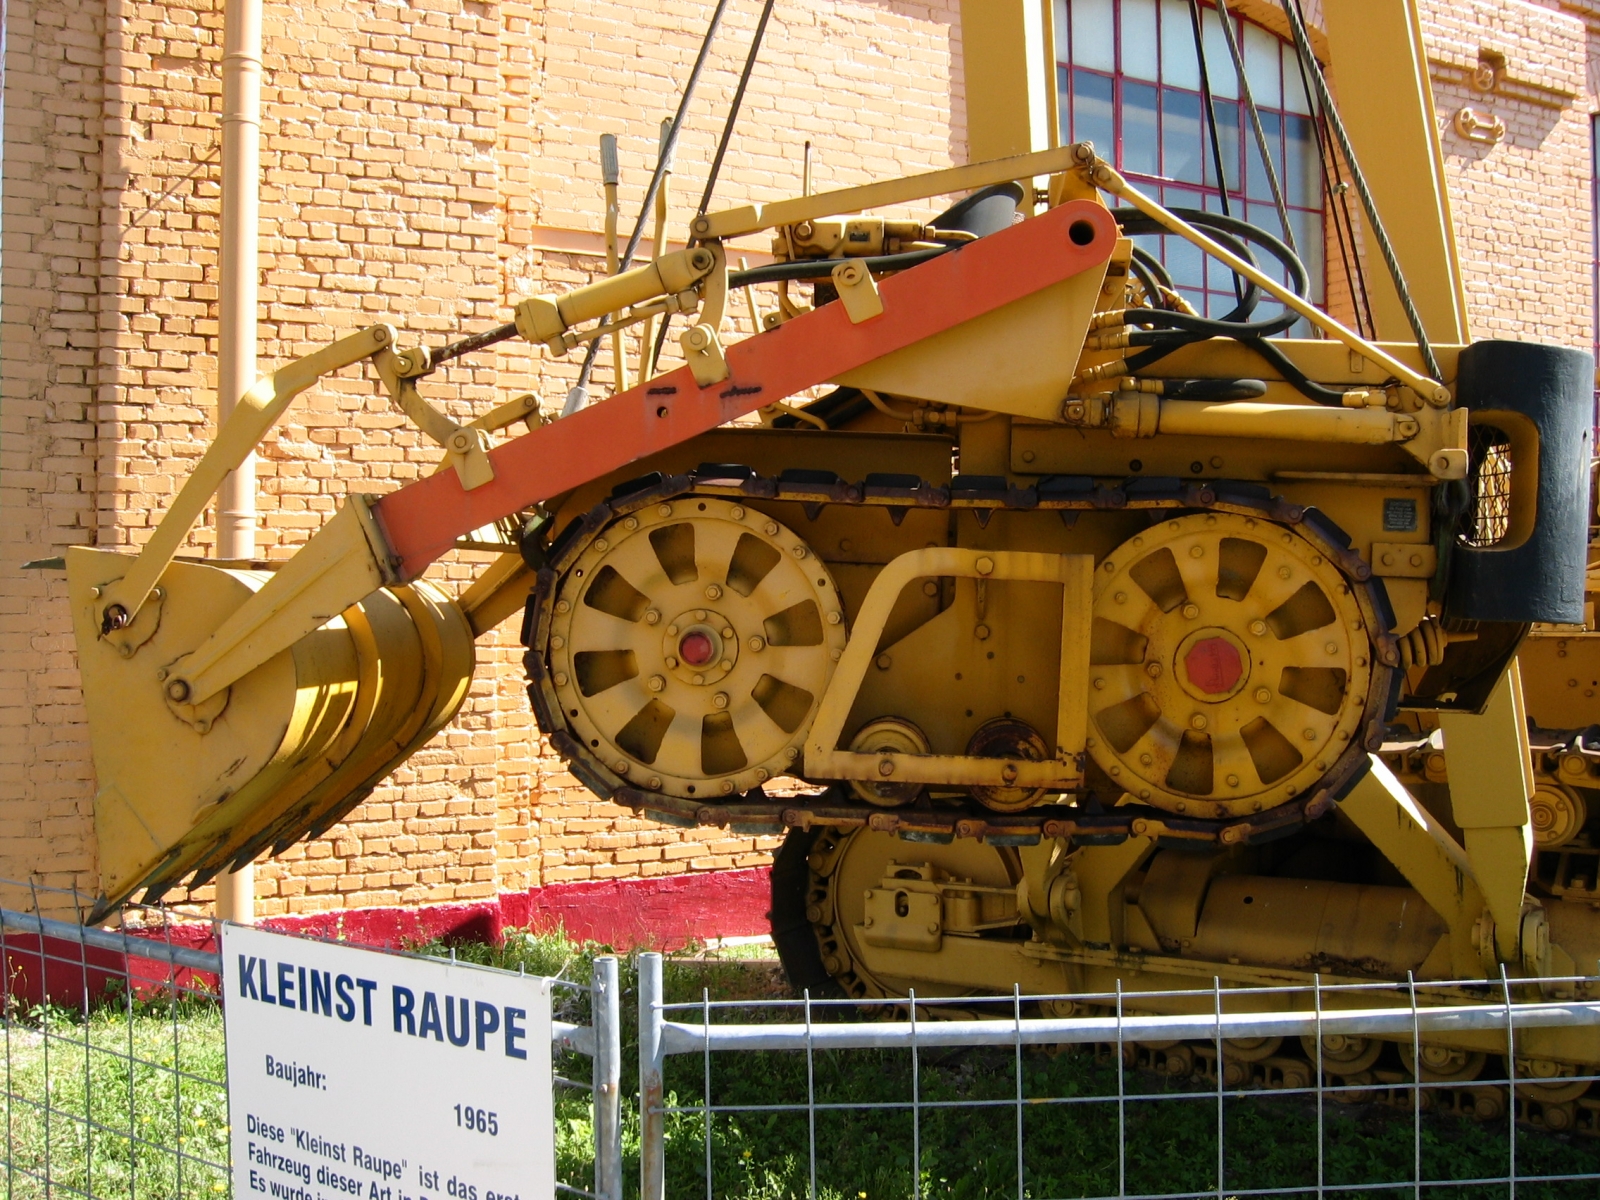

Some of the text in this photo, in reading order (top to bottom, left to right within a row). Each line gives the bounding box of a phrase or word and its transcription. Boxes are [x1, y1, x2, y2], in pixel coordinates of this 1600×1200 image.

[238, 953, 528, 1060] KLEINST RAUPE
[265, 1054, 327, 1091] Baujahr:
[453, 1103, 499, 1137] 1965
[246, 1113, 478, 1200] Diese "Kleinst Raupe" ist das
[248, 1141, 392, 1200] Fahrzeug dieser Art
[249, 1168, 267, 1194] Es
